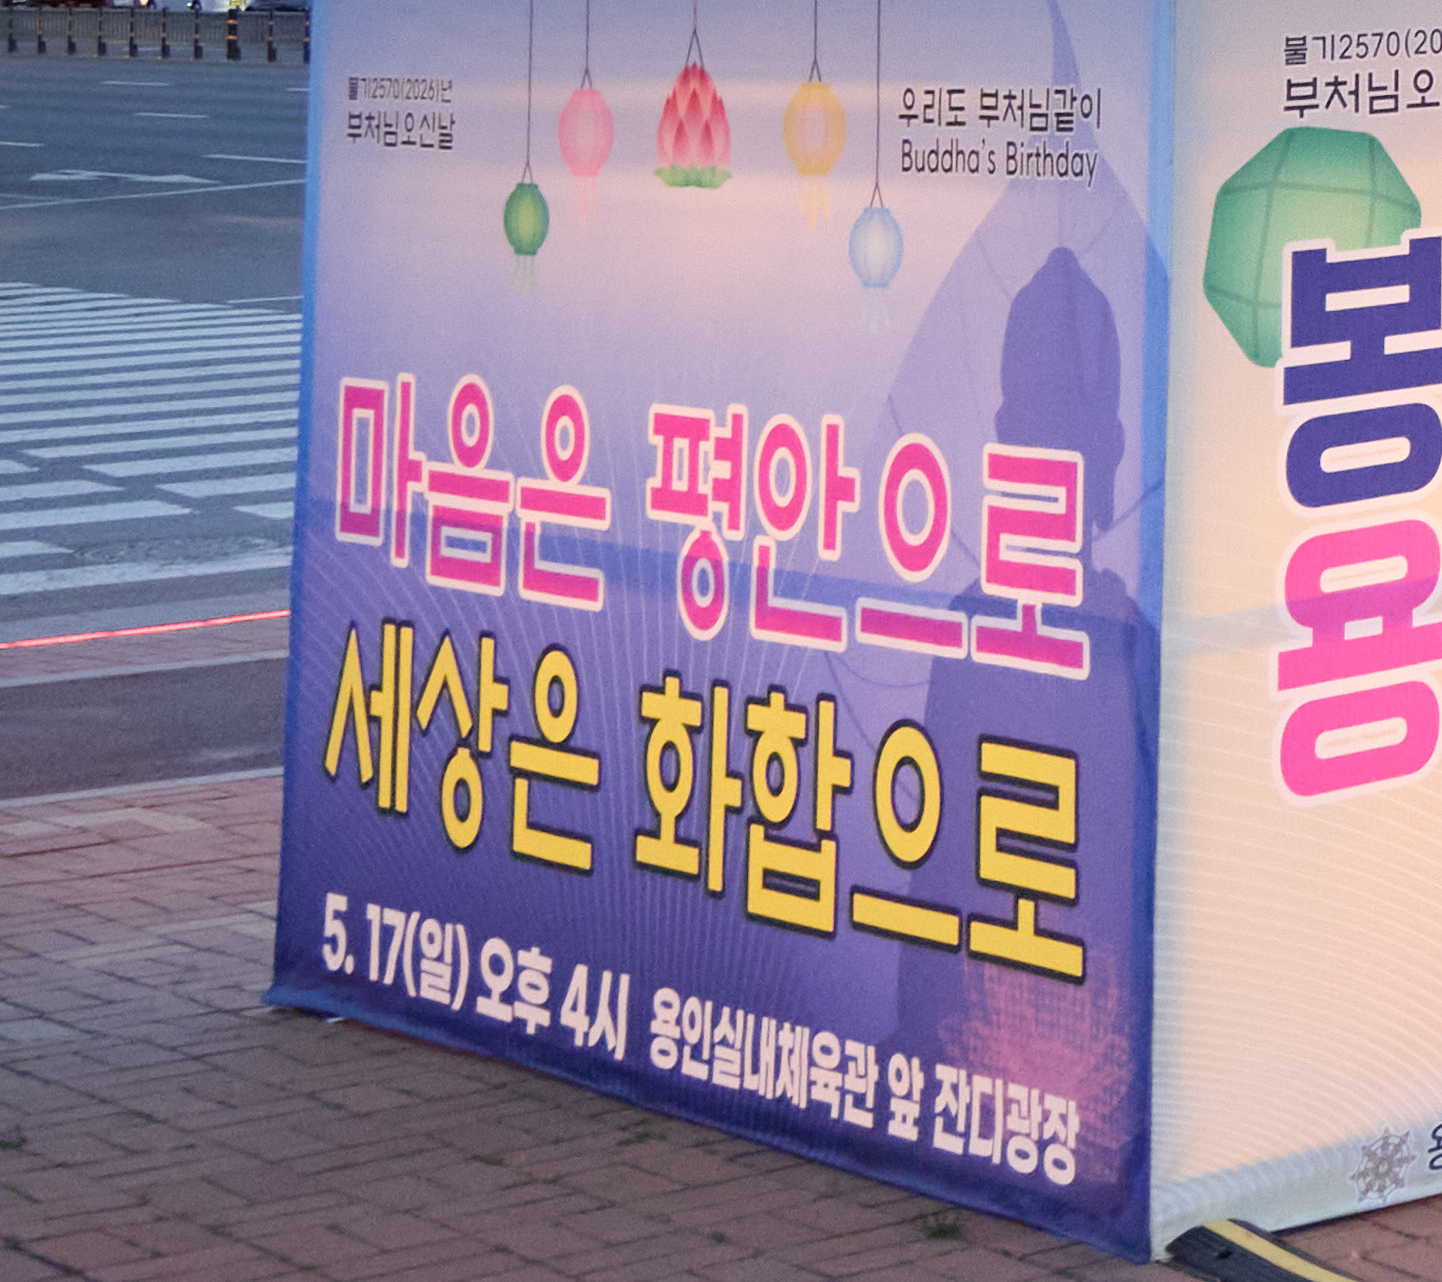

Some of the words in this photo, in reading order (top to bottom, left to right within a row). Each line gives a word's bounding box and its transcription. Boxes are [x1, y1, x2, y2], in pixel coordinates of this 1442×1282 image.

[347, 111, 455, 149] 부처님오신날
[896, 85, 966, 131] 우리도
[977, 85, 1103, 132] 부처님같이
[900, 136, 998, 181] Buddha's
[1005, 140, 1098, 189] Birthday
[334, 372, 612, 611] 마음은
[646, 401, 1091, 680] 평안으로
[323, 619, 603, 877] 세상은
[633, 668, 1087, 986] 화합으로
[322, 892, 356, 975] 5.
[365, 901, 470, 1012] 17(일)
[474, 935, 555, 1038] 오후
[560, 961, 629, 1061] 4시
[649, 986, 880, 1131] 용인실내체육관
[887, 1053, 923, 1141] 앞
[933, 1059, 1081, 1189] 잔디광장
